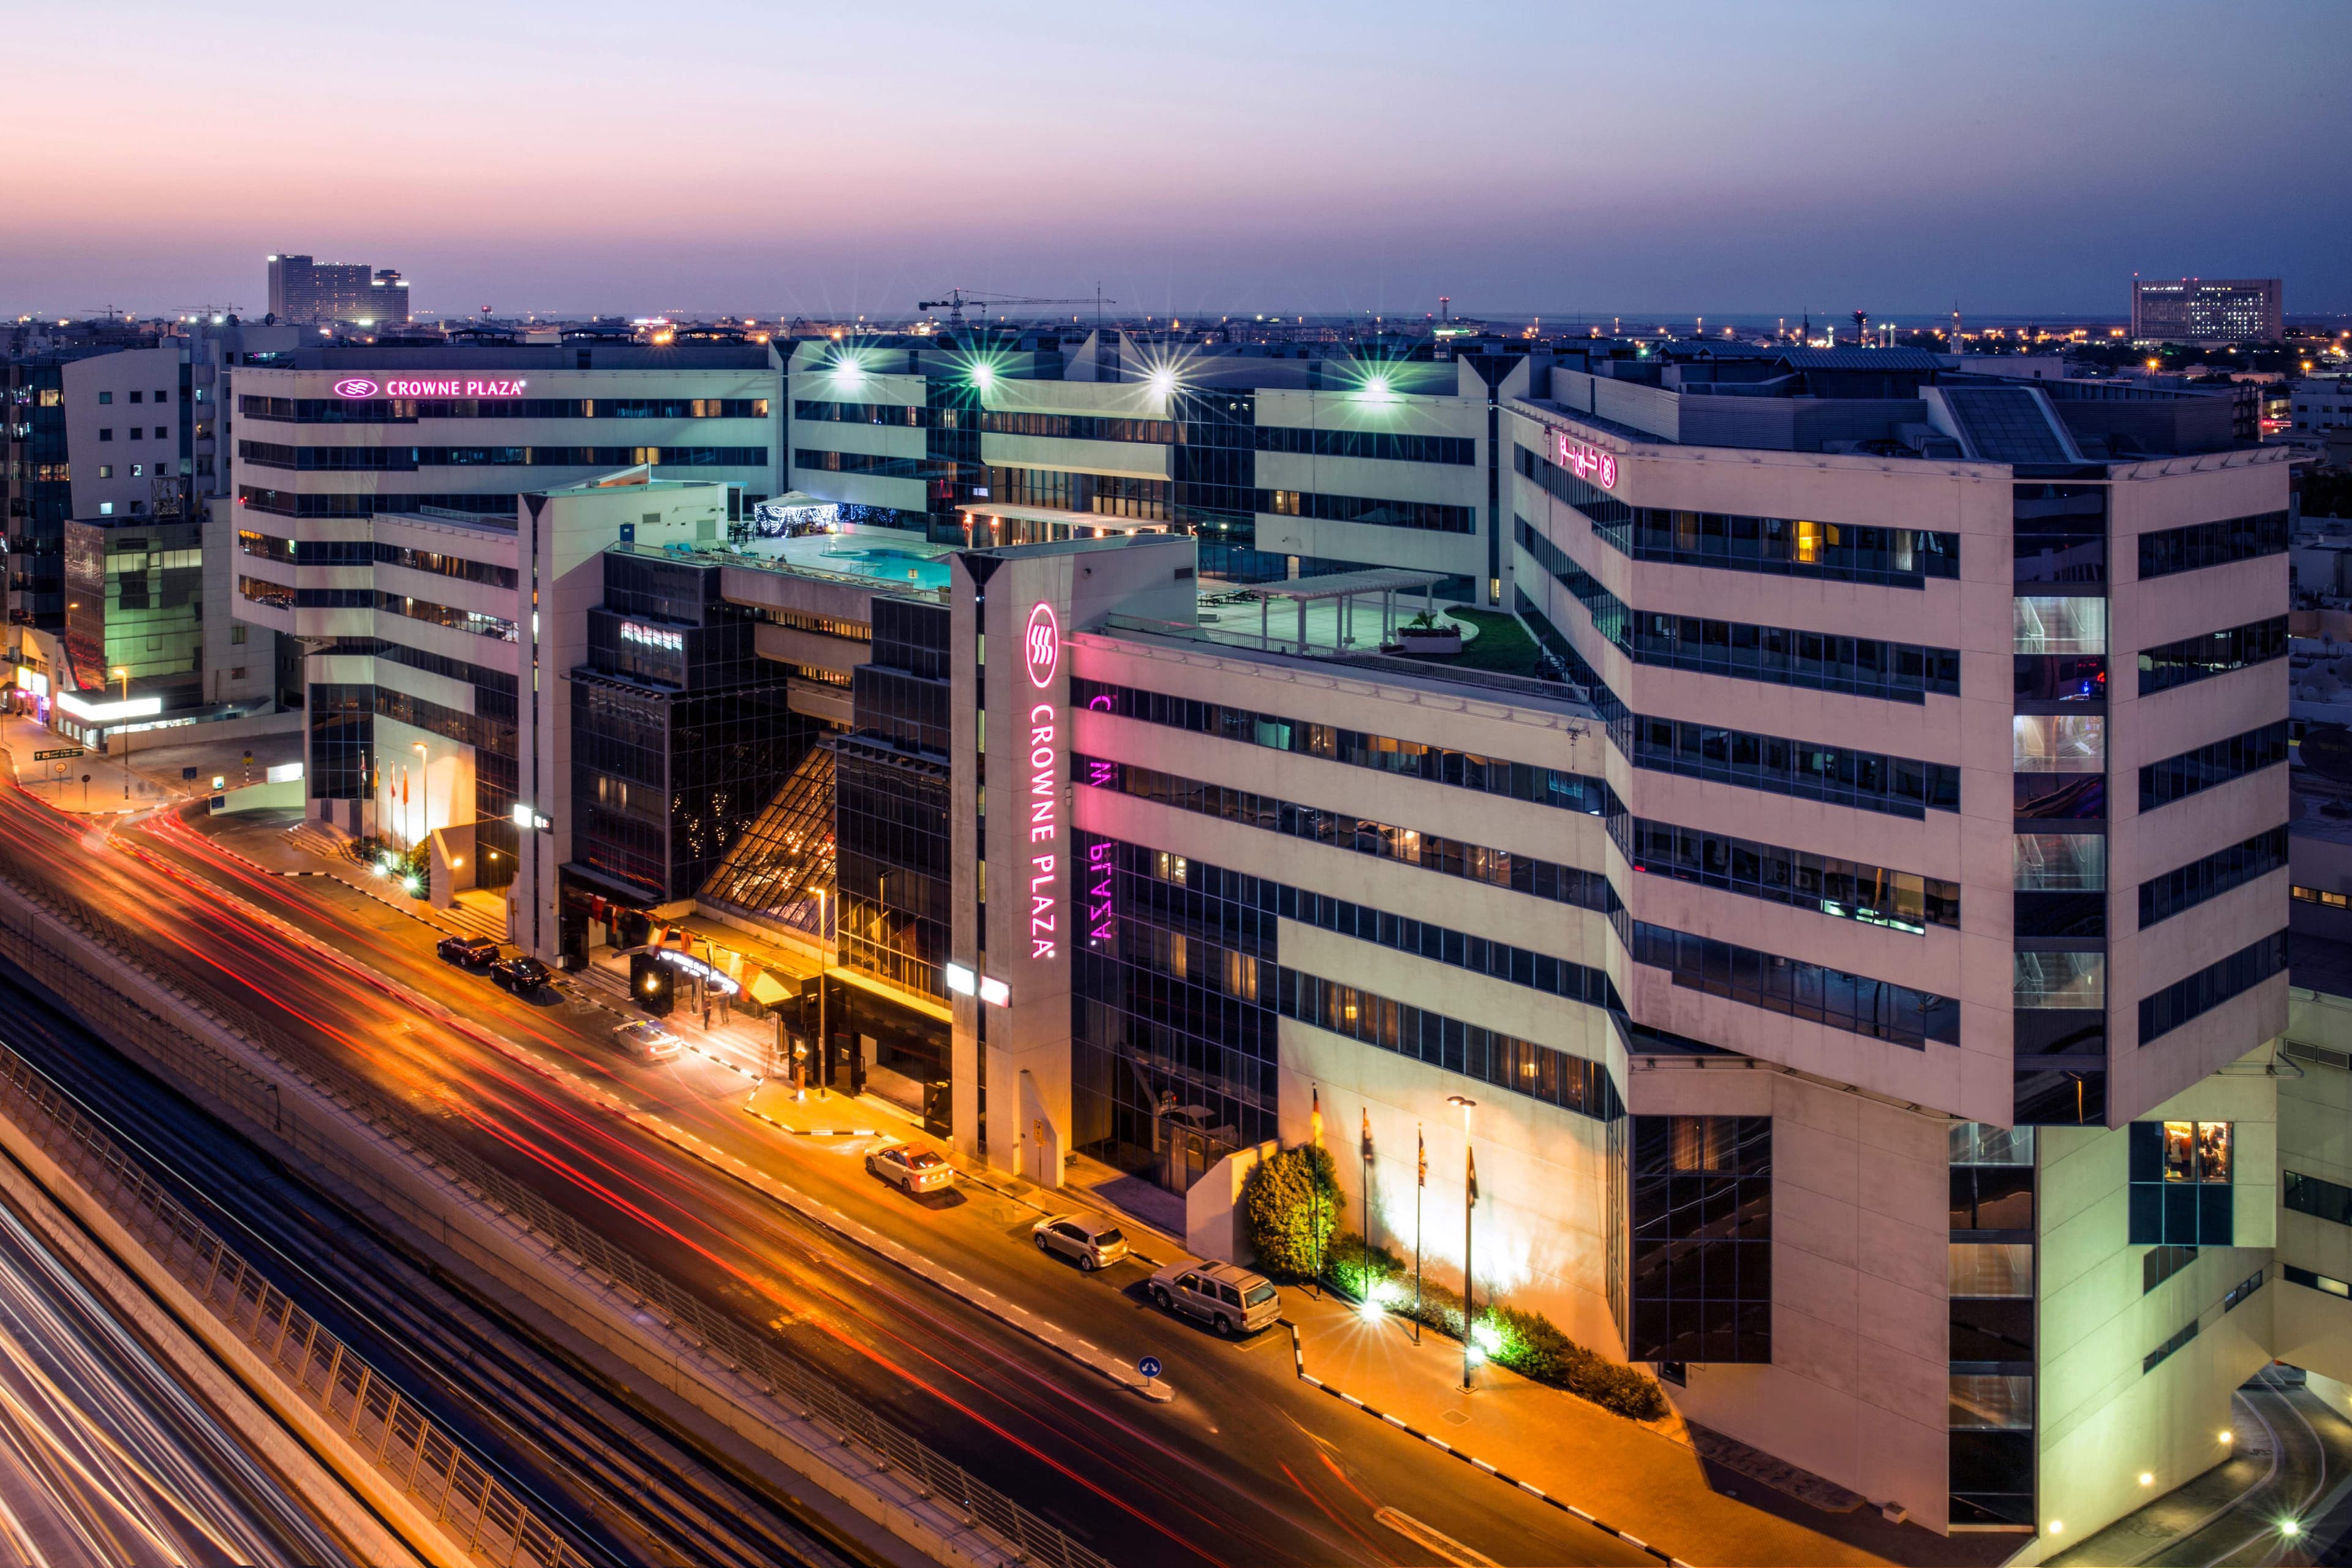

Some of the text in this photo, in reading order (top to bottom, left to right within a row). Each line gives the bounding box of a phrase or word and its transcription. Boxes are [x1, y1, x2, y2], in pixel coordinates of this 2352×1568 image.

[387, 381, 521, 396] CROWNE PLAZA
[1031, 704, 1055, 959] CROWNE PLAZA
